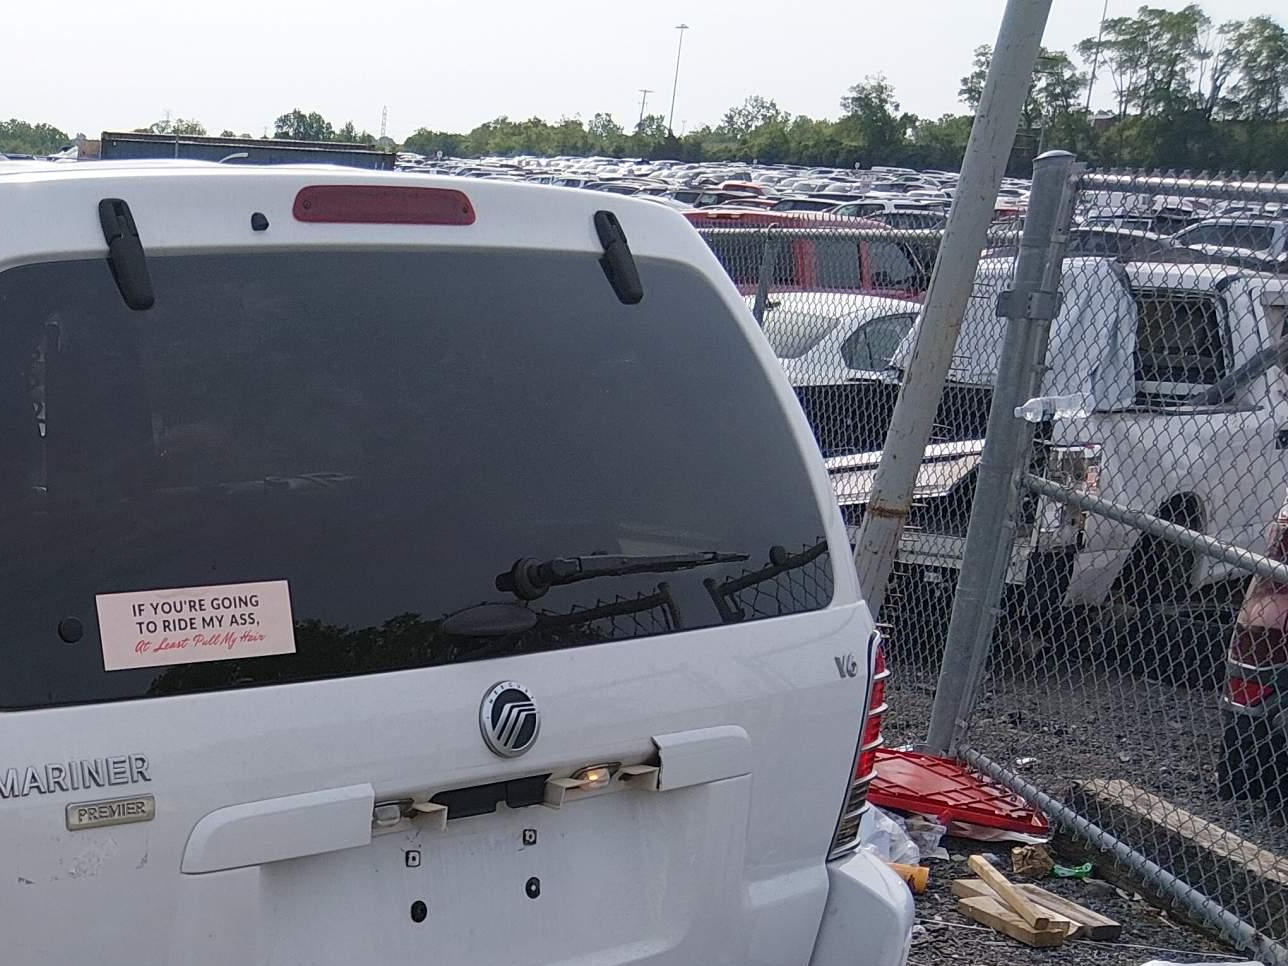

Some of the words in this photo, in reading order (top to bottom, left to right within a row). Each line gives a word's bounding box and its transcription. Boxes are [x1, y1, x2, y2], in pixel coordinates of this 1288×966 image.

[132, 604, 145, 617] IF
[150, 599, 206, 615] YOU'RE
[211, 595, 260, 611] GOING
[136, 621, 157, 635] TO
[163, 617, 197, 633] RIDE
[202, 615, 225, 629] MY
[229, 612, 261, 628] ASS,
[135, 640, 152, 654] At
[153, 637, 190, 653] Least
[192, 633, 222, 647] Pull
[219, 631, 237, 650] My
[239, 630, 266, 643] Hair
[834, 652, 857, 679] V6
[78, 801, 147, 823] PREMIER
